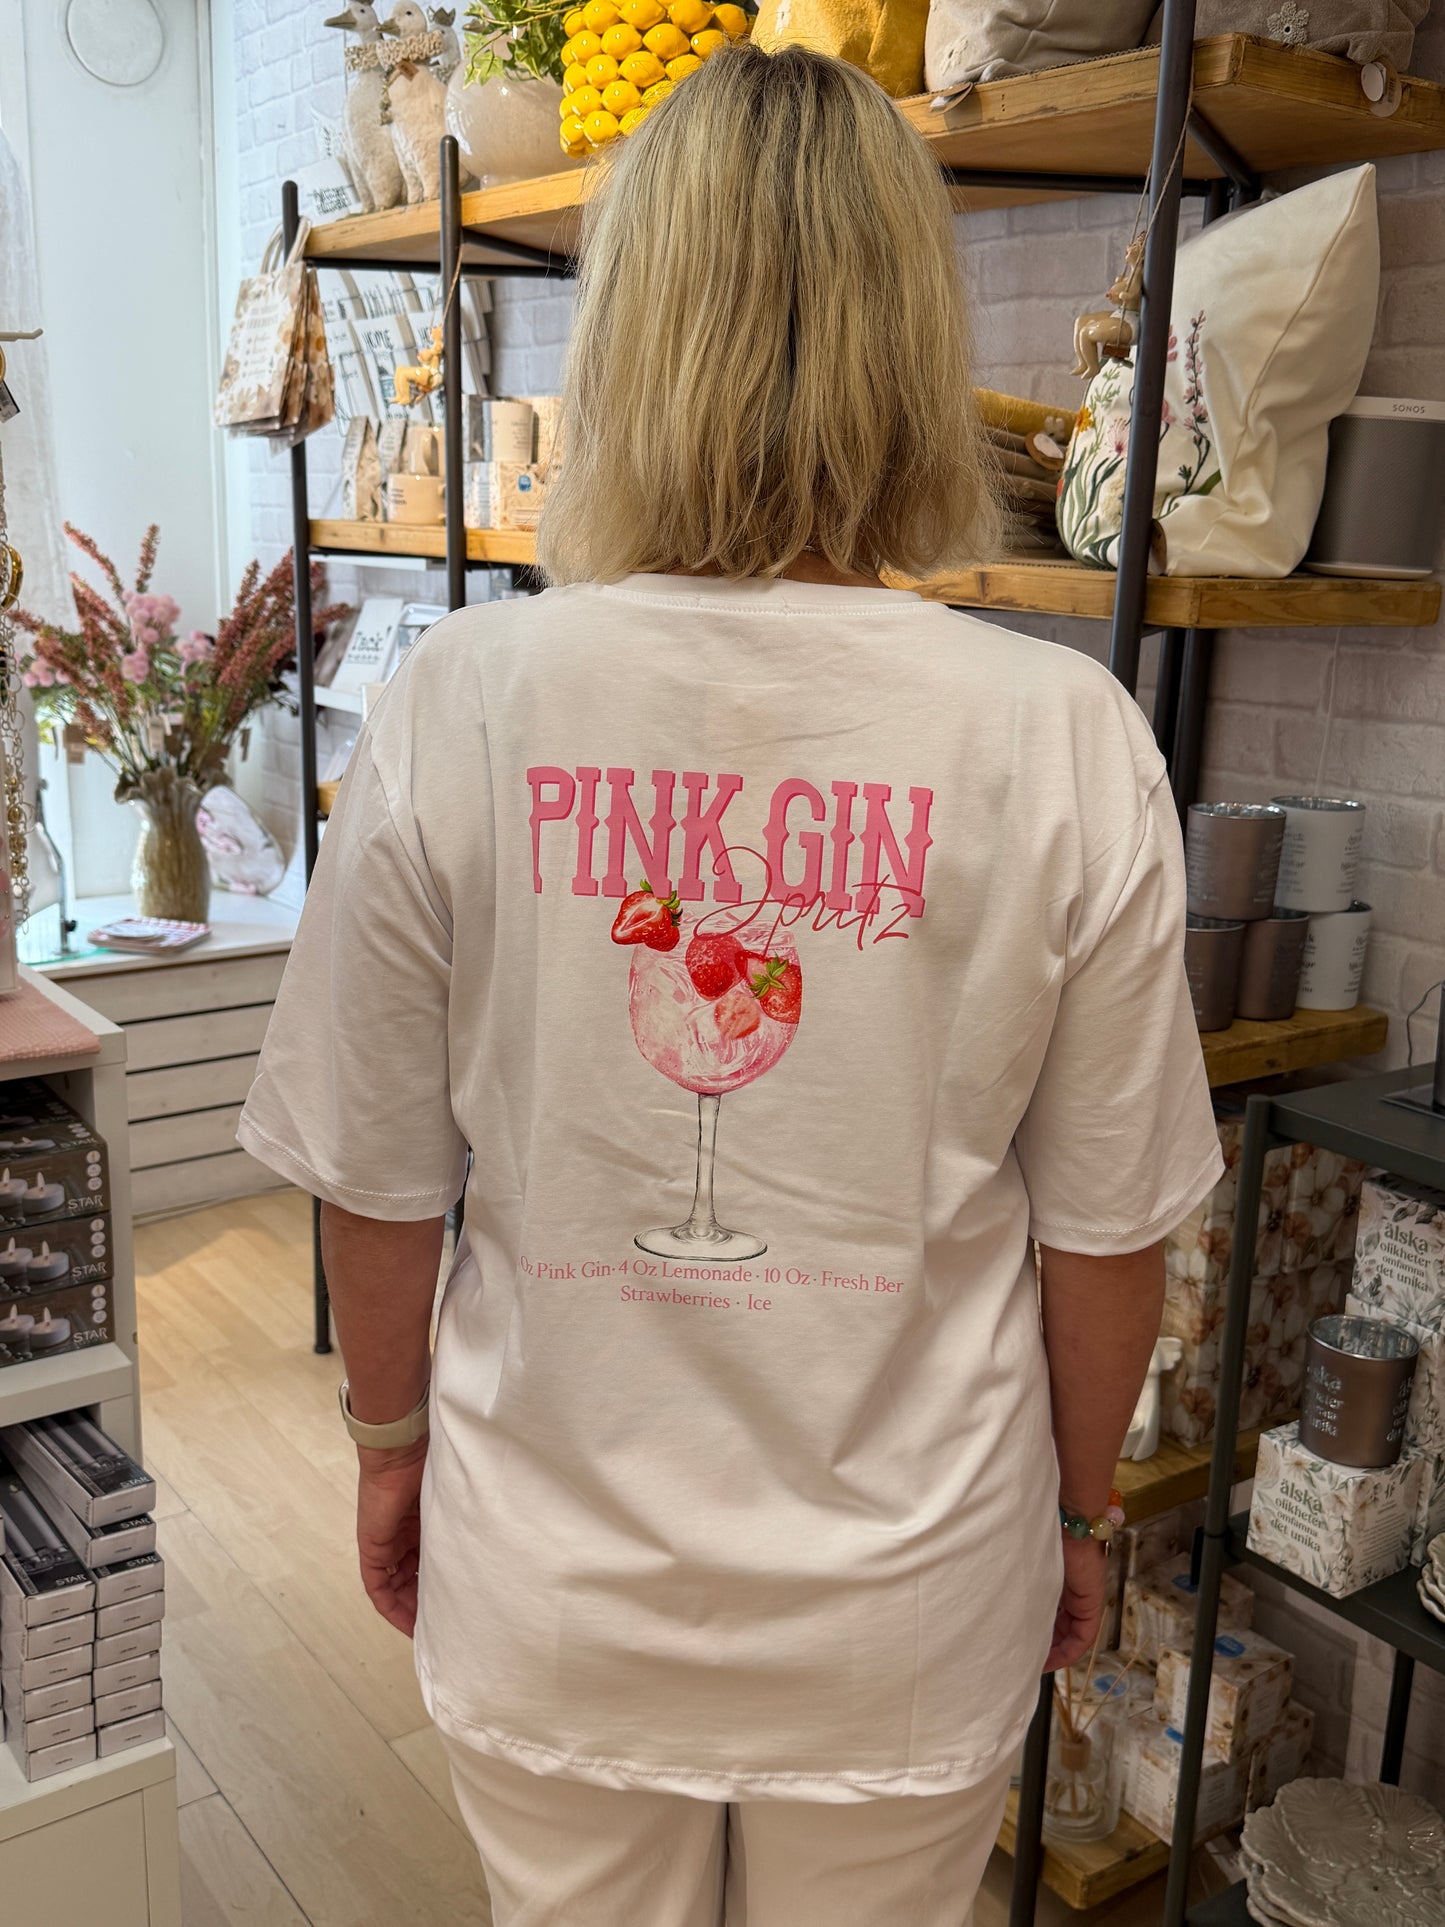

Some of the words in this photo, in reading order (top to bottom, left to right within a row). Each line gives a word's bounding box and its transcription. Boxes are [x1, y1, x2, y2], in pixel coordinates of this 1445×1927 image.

[1392, 404, 1425, 414] SONOS
[526, 766, 743, 903] PINK
[762, 778, 934, 918] GIN
[67, 1194, 104, 1210] STAR
[1384, 1222, 1428, 1255] älska
[1380, 1242, 1431, 1267] olikheter
[1382, 1256, 1425, 1277] omfamna
[72, 1261, 107, 1277] STAR
[537, 1262, 576, 1280] Pink
[618, 1259, 628, 1275] 4
[633, 1259, 658, 1277] Oz
[662, 1261, 752, 1283] Lemonade
[764, 1267, 781, 1284] 10
[785, 1267, 810, 1286] Oz
[821, 1270, 869, 1292] Fresh
[1376, 1263, 1393, 1278] det
[1397, 1273, 1428, 1292] unika
[620, 1285, 730, 1309] Strawberries
[747, 1293, 772, 1311] Ice
[73, 1327, 108, 1343] STAR
[120, 1476, 150, 1489] STAR
[1280, 1478, 1322, 1515] älska
[121, 1517, 151, 1529] STAR
[1275, 1498, 1322, 1528] olikheter
[1277, 1511, 1318, 1537] omfamna
[1270, 1518, 1288, 1534] det
[1291, 1530, 1321, 1552] unika
[126, 1555, 157, 1567] STAR
[55, 1574, 87, 1586] STAR
